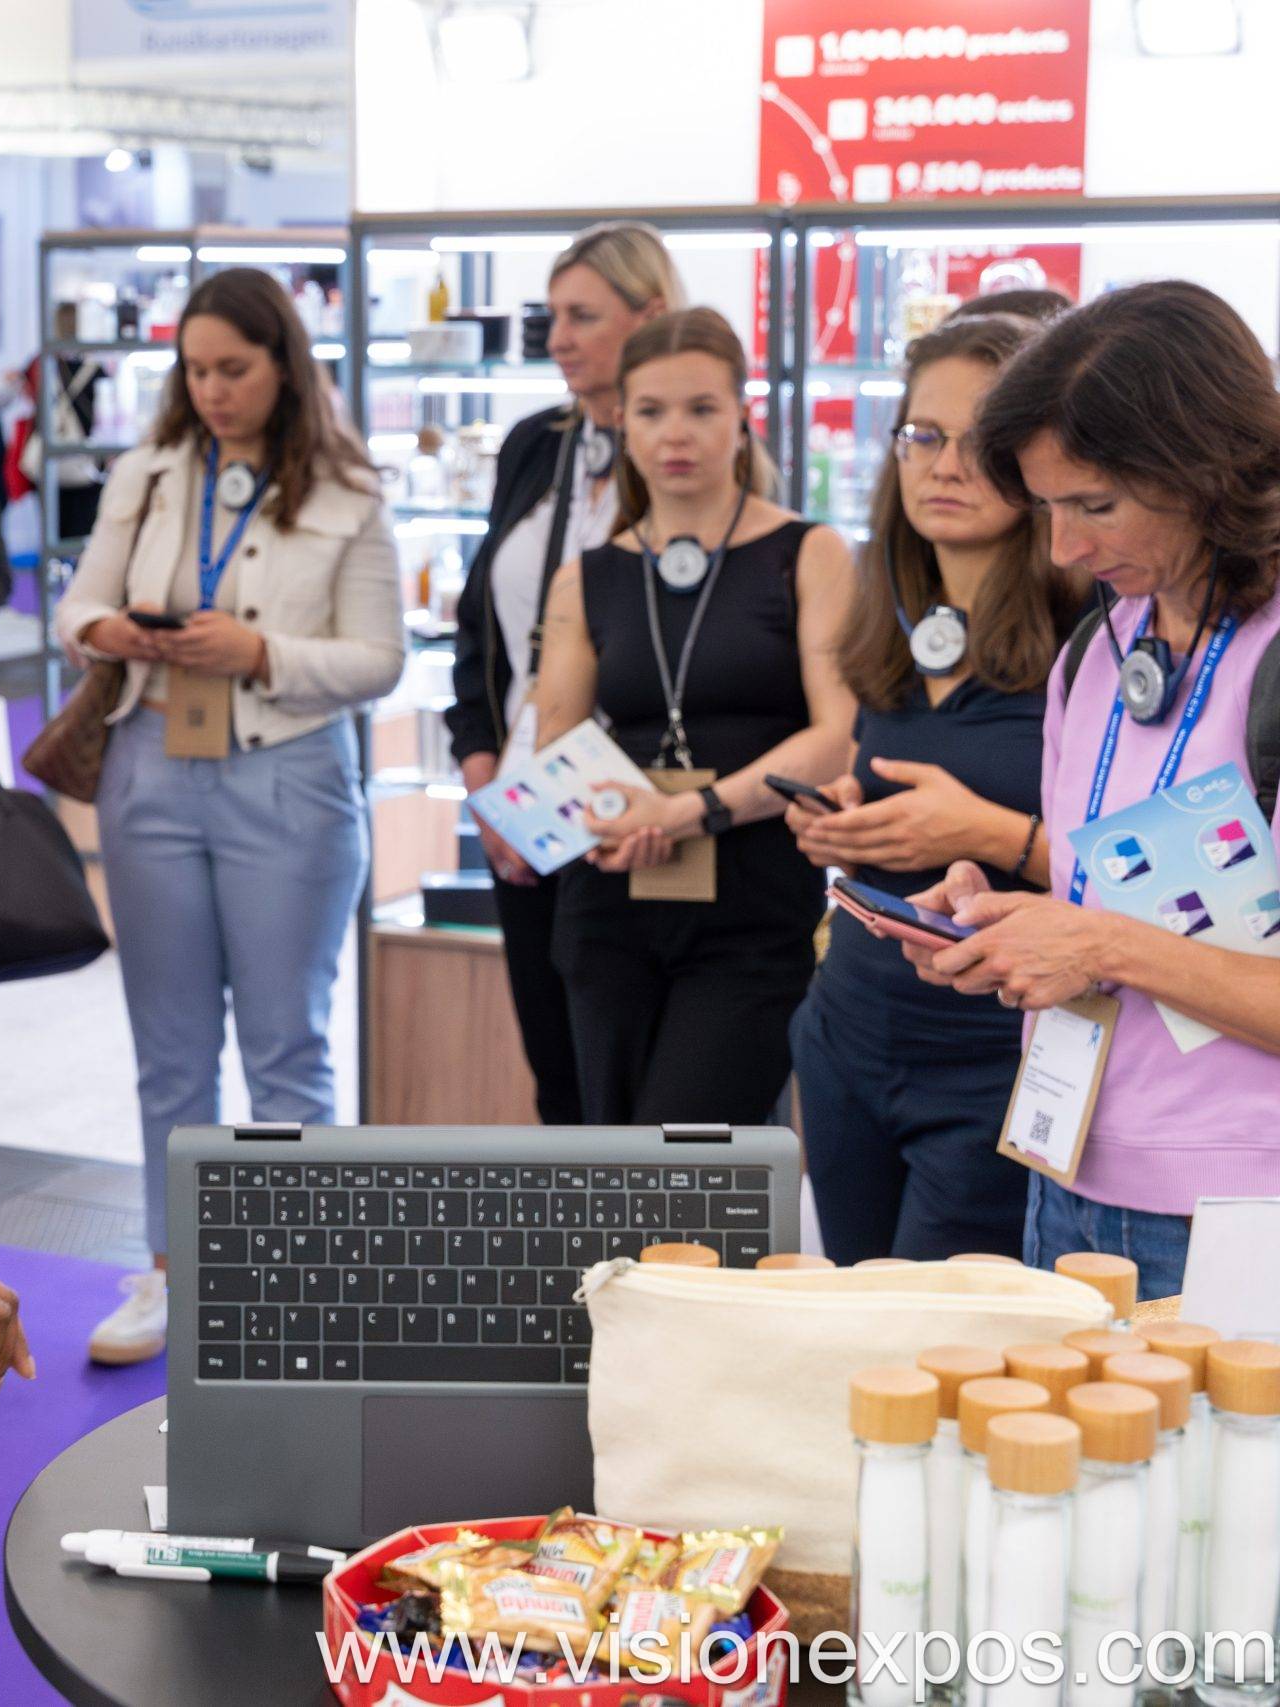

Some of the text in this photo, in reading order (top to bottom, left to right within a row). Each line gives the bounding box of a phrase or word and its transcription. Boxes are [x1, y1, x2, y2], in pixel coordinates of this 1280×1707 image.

[281, 1211, 287, 1221] 2
[320, 1211, 326, 1221] 3
[359, 1212, 365, 1220] 4
[399, 1212, 405, 1221] 5
[437, 1213, 444, 1221] 6
[478, 1212, 484, 1221] 7
[517, 1213, 524, 1222] 8
[557, 1213, 564, 1222] 9
[596, 1213, 604, 1222] 0
[726, 1207, 758, 1215] Backspace
[256, 1235, 265, 1246] Q
[295, 1235, 306, 1245] W
[335, 1235, 342, 1246] E
[375, 1235, 382, 1245] R
[415, 1236, 421, 1245] T
[454, 1236, 461, 1246] Z
[493, 1237, 502, 1247] U
[572, 1237, 581, 1247] O
[613, 1237, 620, 1246] P
[270, 1273, 553, 1285] A S D F G H J K
[289, 1312, 297, 1321] Y
[329, 1313, 336, 1322] X
[368, 1313, 375, 1323] C
[408, 1313, 416, 1323] V
[447, 1313, 455, 1324] B
[487, 1314, 495, 1323] N
[526, 1314, 536, 1323] M
[209, 1358, 223, 1366] Strg
